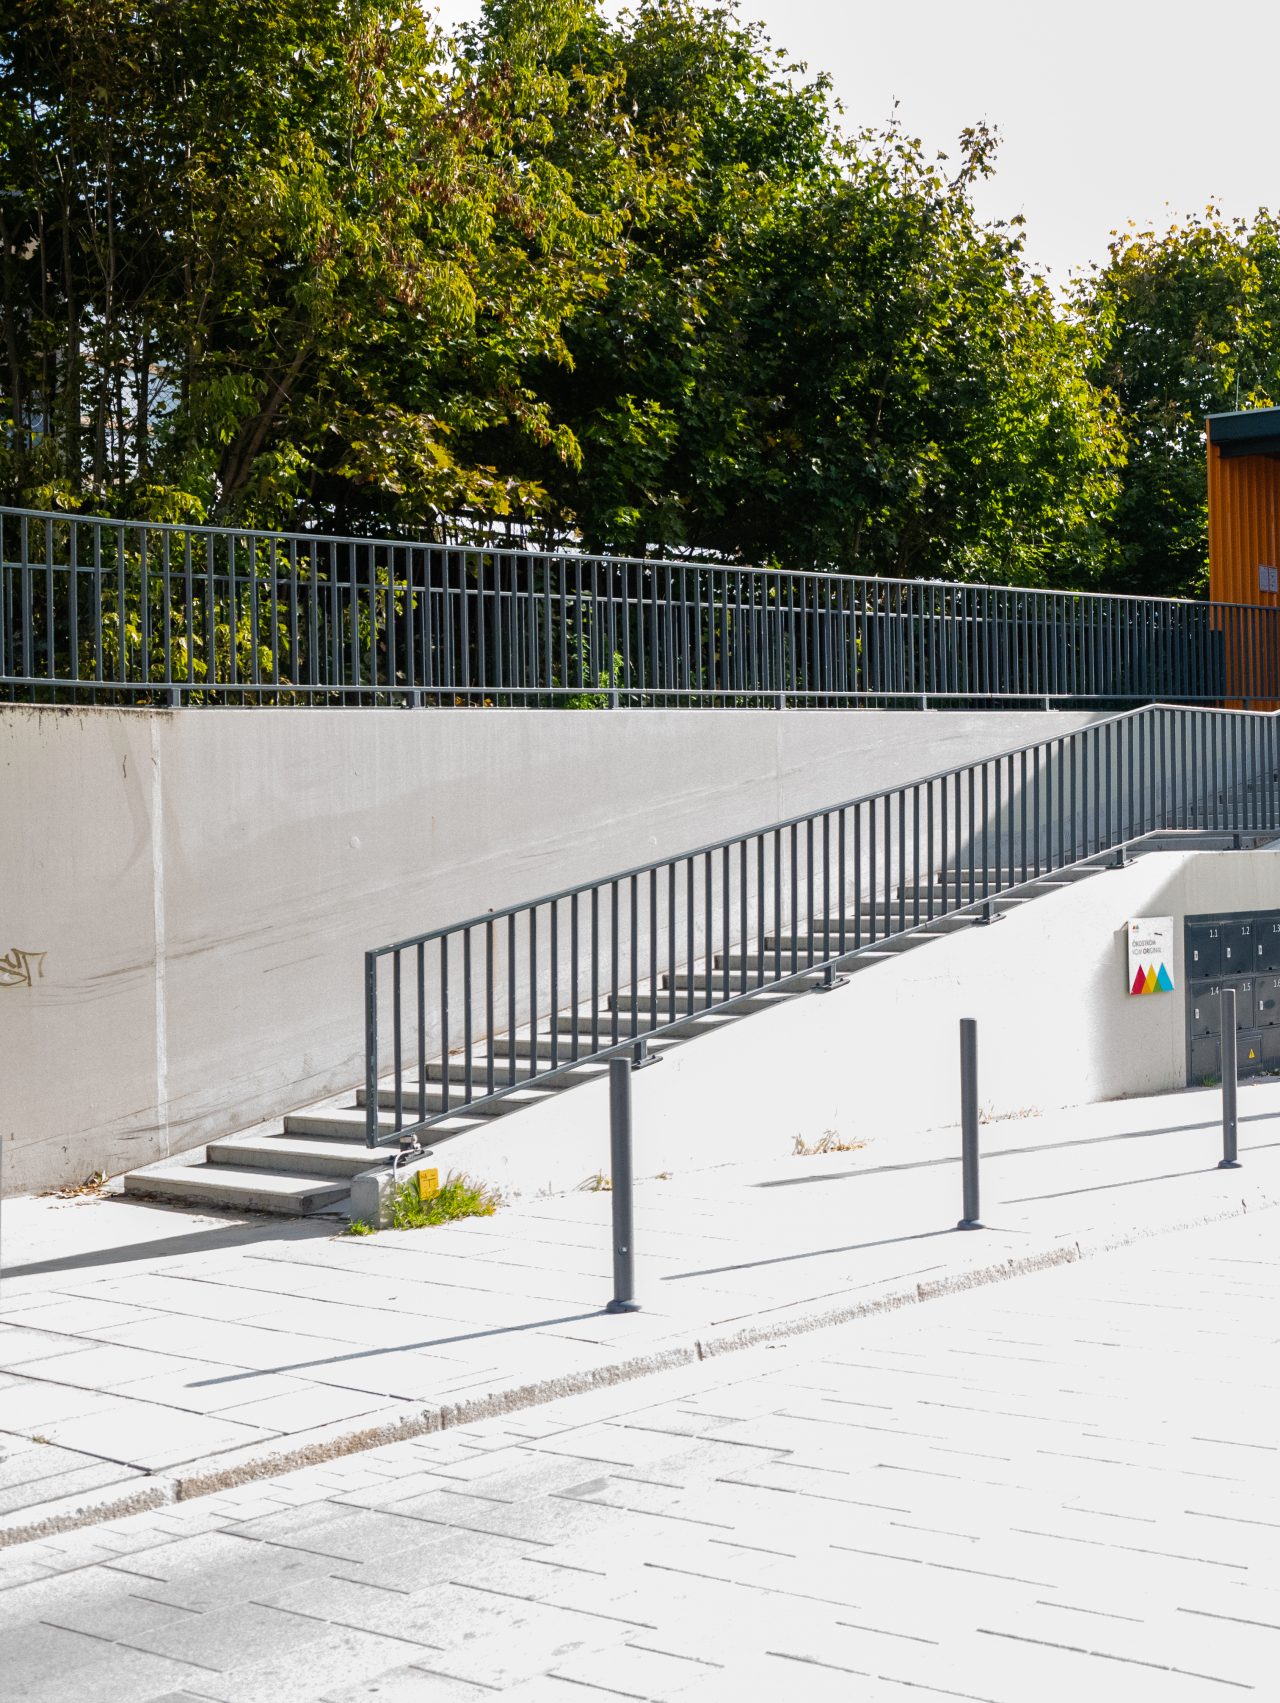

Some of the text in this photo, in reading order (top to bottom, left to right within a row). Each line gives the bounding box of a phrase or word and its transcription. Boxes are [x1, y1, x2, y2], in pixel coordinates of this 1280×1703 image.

[1241, 926, 1250, 935] 1.2
[1272, 924, 1280, 933] 1.3
[1209, 929, 1218, 938] 1.1
[1210, 986, 1219, 996] 1.4
[1242, 982, 1251, 992] 1.5
